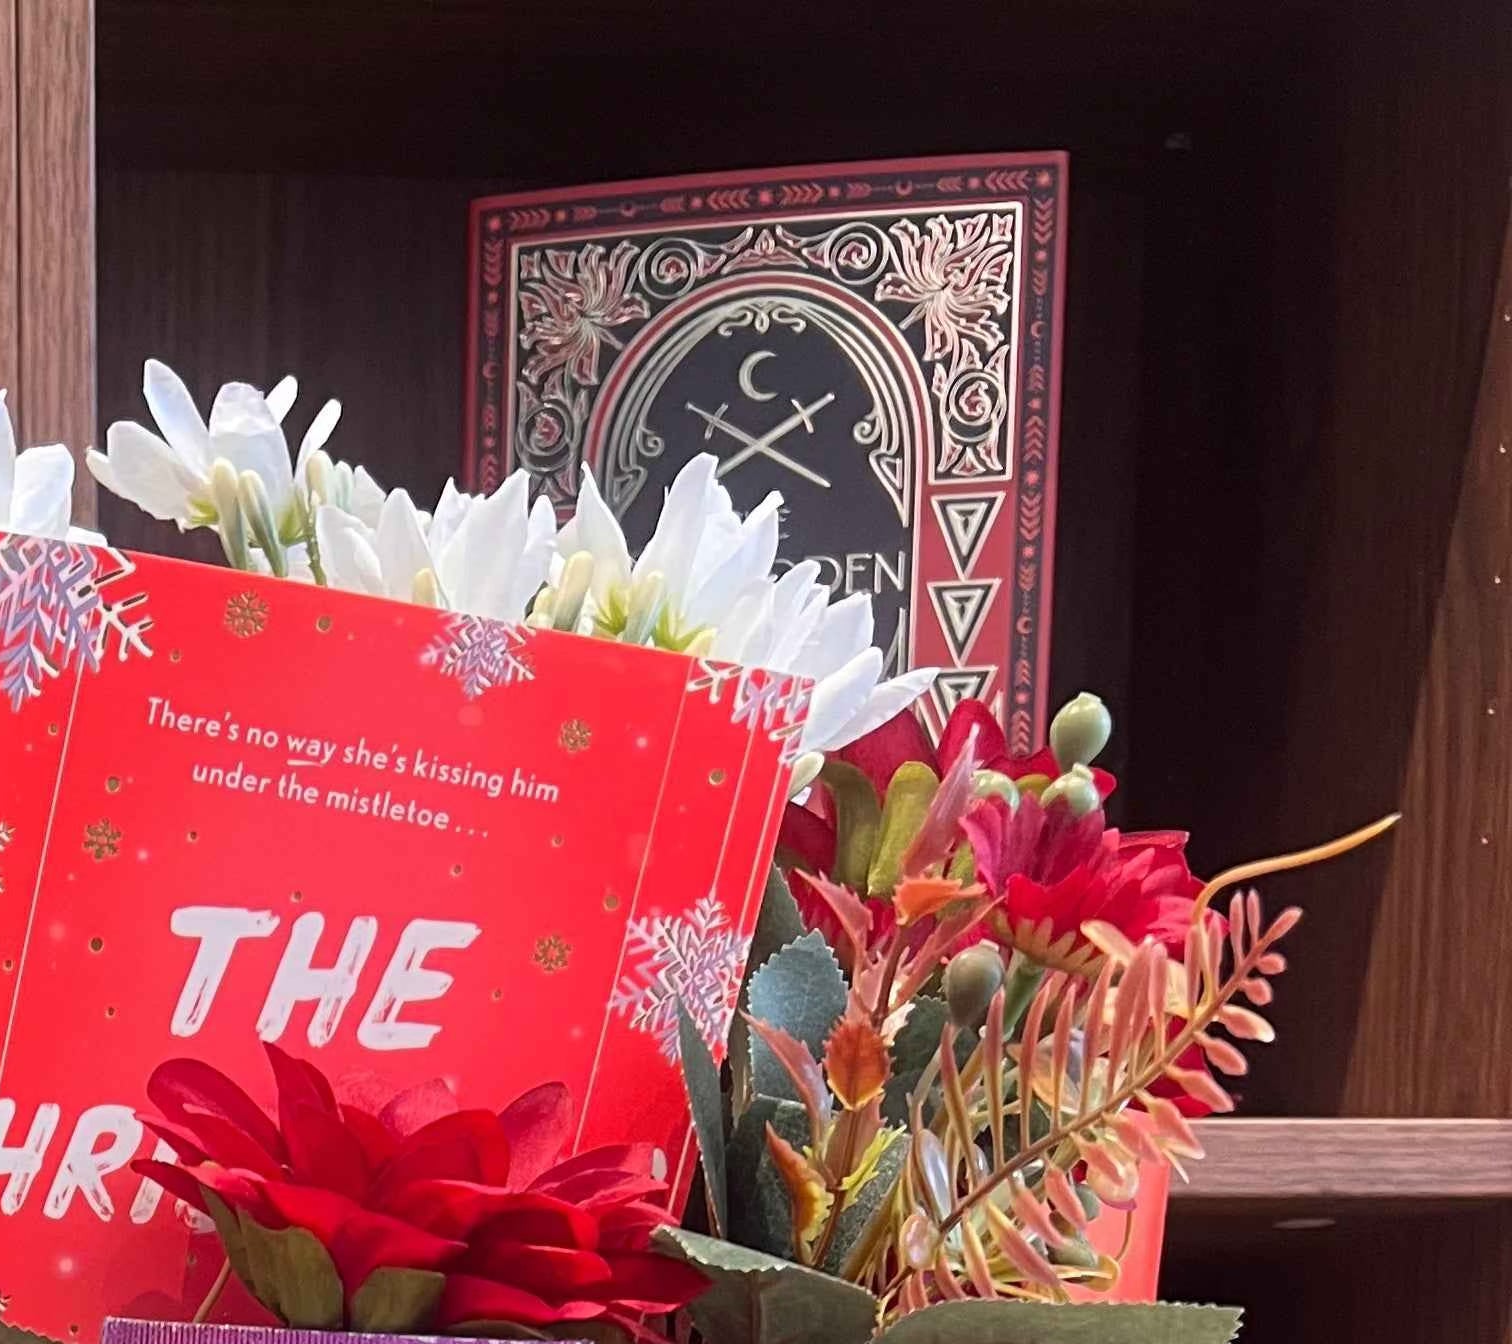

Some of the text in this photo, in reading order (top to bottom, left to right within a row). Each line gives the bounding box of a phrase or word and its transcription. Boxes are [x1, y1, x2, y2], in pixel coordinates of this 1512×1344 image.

[147, 696, 560, 803] There's no way she's kissing him
[192, 762, 272, 795] under
[277, 773, 320, 804] the
[168, 903, 483, 1052] THE
